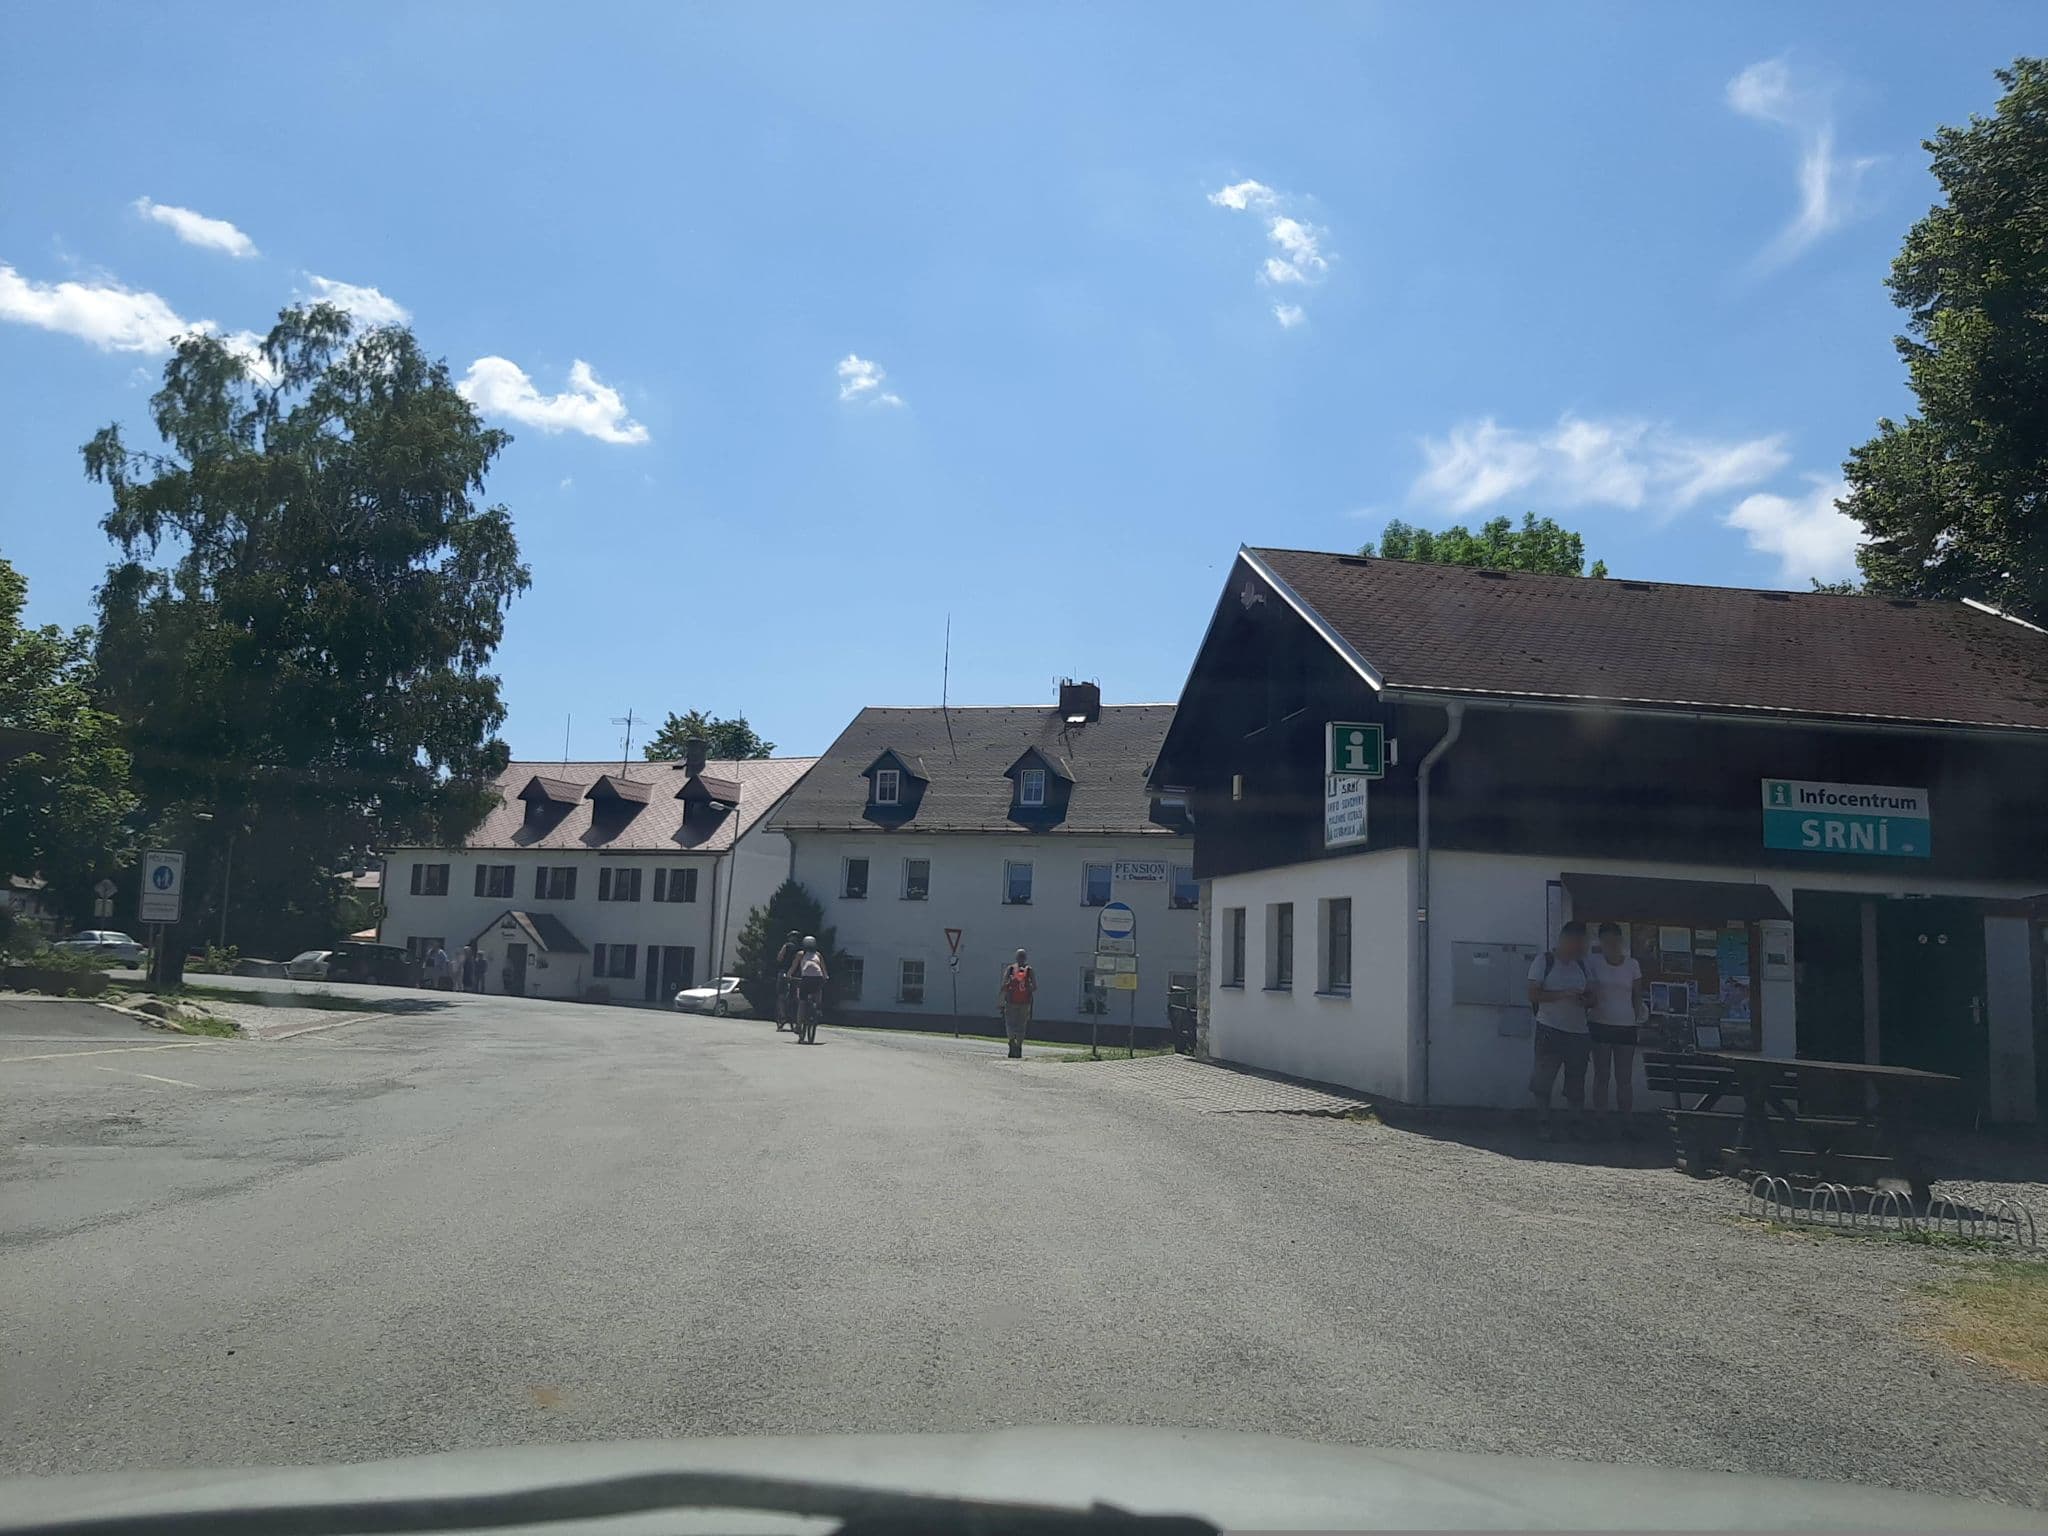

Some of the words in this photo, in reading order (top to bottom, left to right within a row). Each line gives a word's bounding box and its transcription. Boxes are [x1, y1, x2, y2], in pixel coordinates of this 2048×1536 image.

[1799, 788, 1917, 810] Infocentrum
[1801, 818, 1889, 851] SRNÍ
[1115, 862, 1165, 874] PENSION
